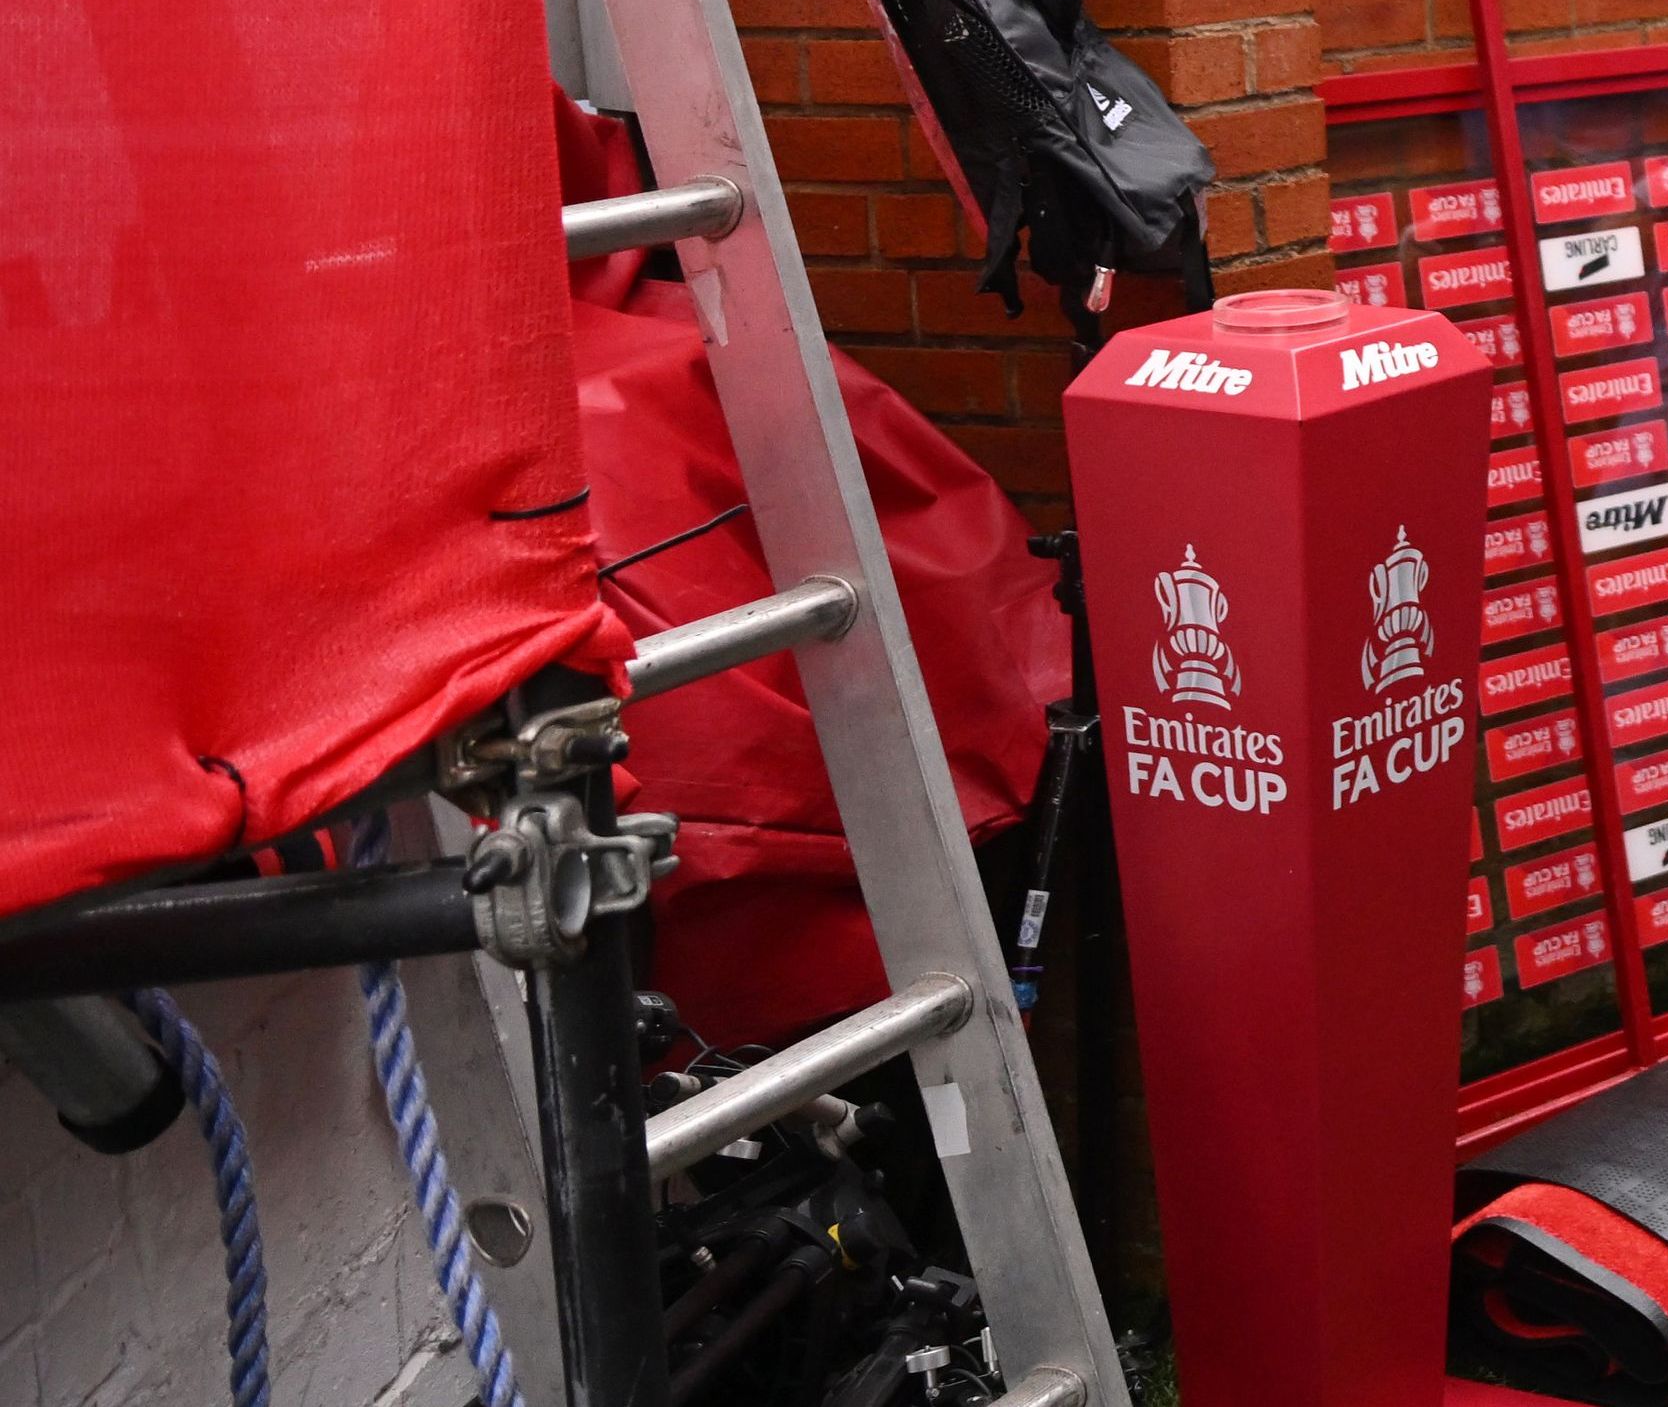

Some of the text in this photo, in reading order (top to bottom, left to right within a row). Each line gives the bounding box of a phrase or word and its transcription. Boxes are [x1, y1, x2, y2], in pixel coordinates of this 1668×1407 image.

[1427, 193, 1476, 211] FA CUP
[1539, 175, 1627, 205] Emirates
[1563, 233, 1619, 258] CARLING
[1566, 308, 1612, 327] FA CUP
[1125, 349, 1252, 396] Mitre
[1341, 340, 1439, 391] Mitre
[1567, 371, 1654, 405] Emirates
[1585, 437, 1630, 458] FA CUP
[1584, 494, 1668, 531] Mitre
[1484, 527, 1523, 547] FA CU
[1484, 592, 1532, 615] FA CUP
[1612, 630, 1657, 653] FA CUP
[1333, 677, 1463, 760] Emirates
[1123, 706, 1285, 766] Emirates
[1503, 725, 1551, 750] FA CUP
[1333, 716, 1464, 810] FA CUP
[1631, 764, 1659, 783] CUP
[1128, 753, 1288, 815] FA CUP
[1522, 861, 1570, 887] FA CUP
[1532, 929, 1580, 956] FA CUP
